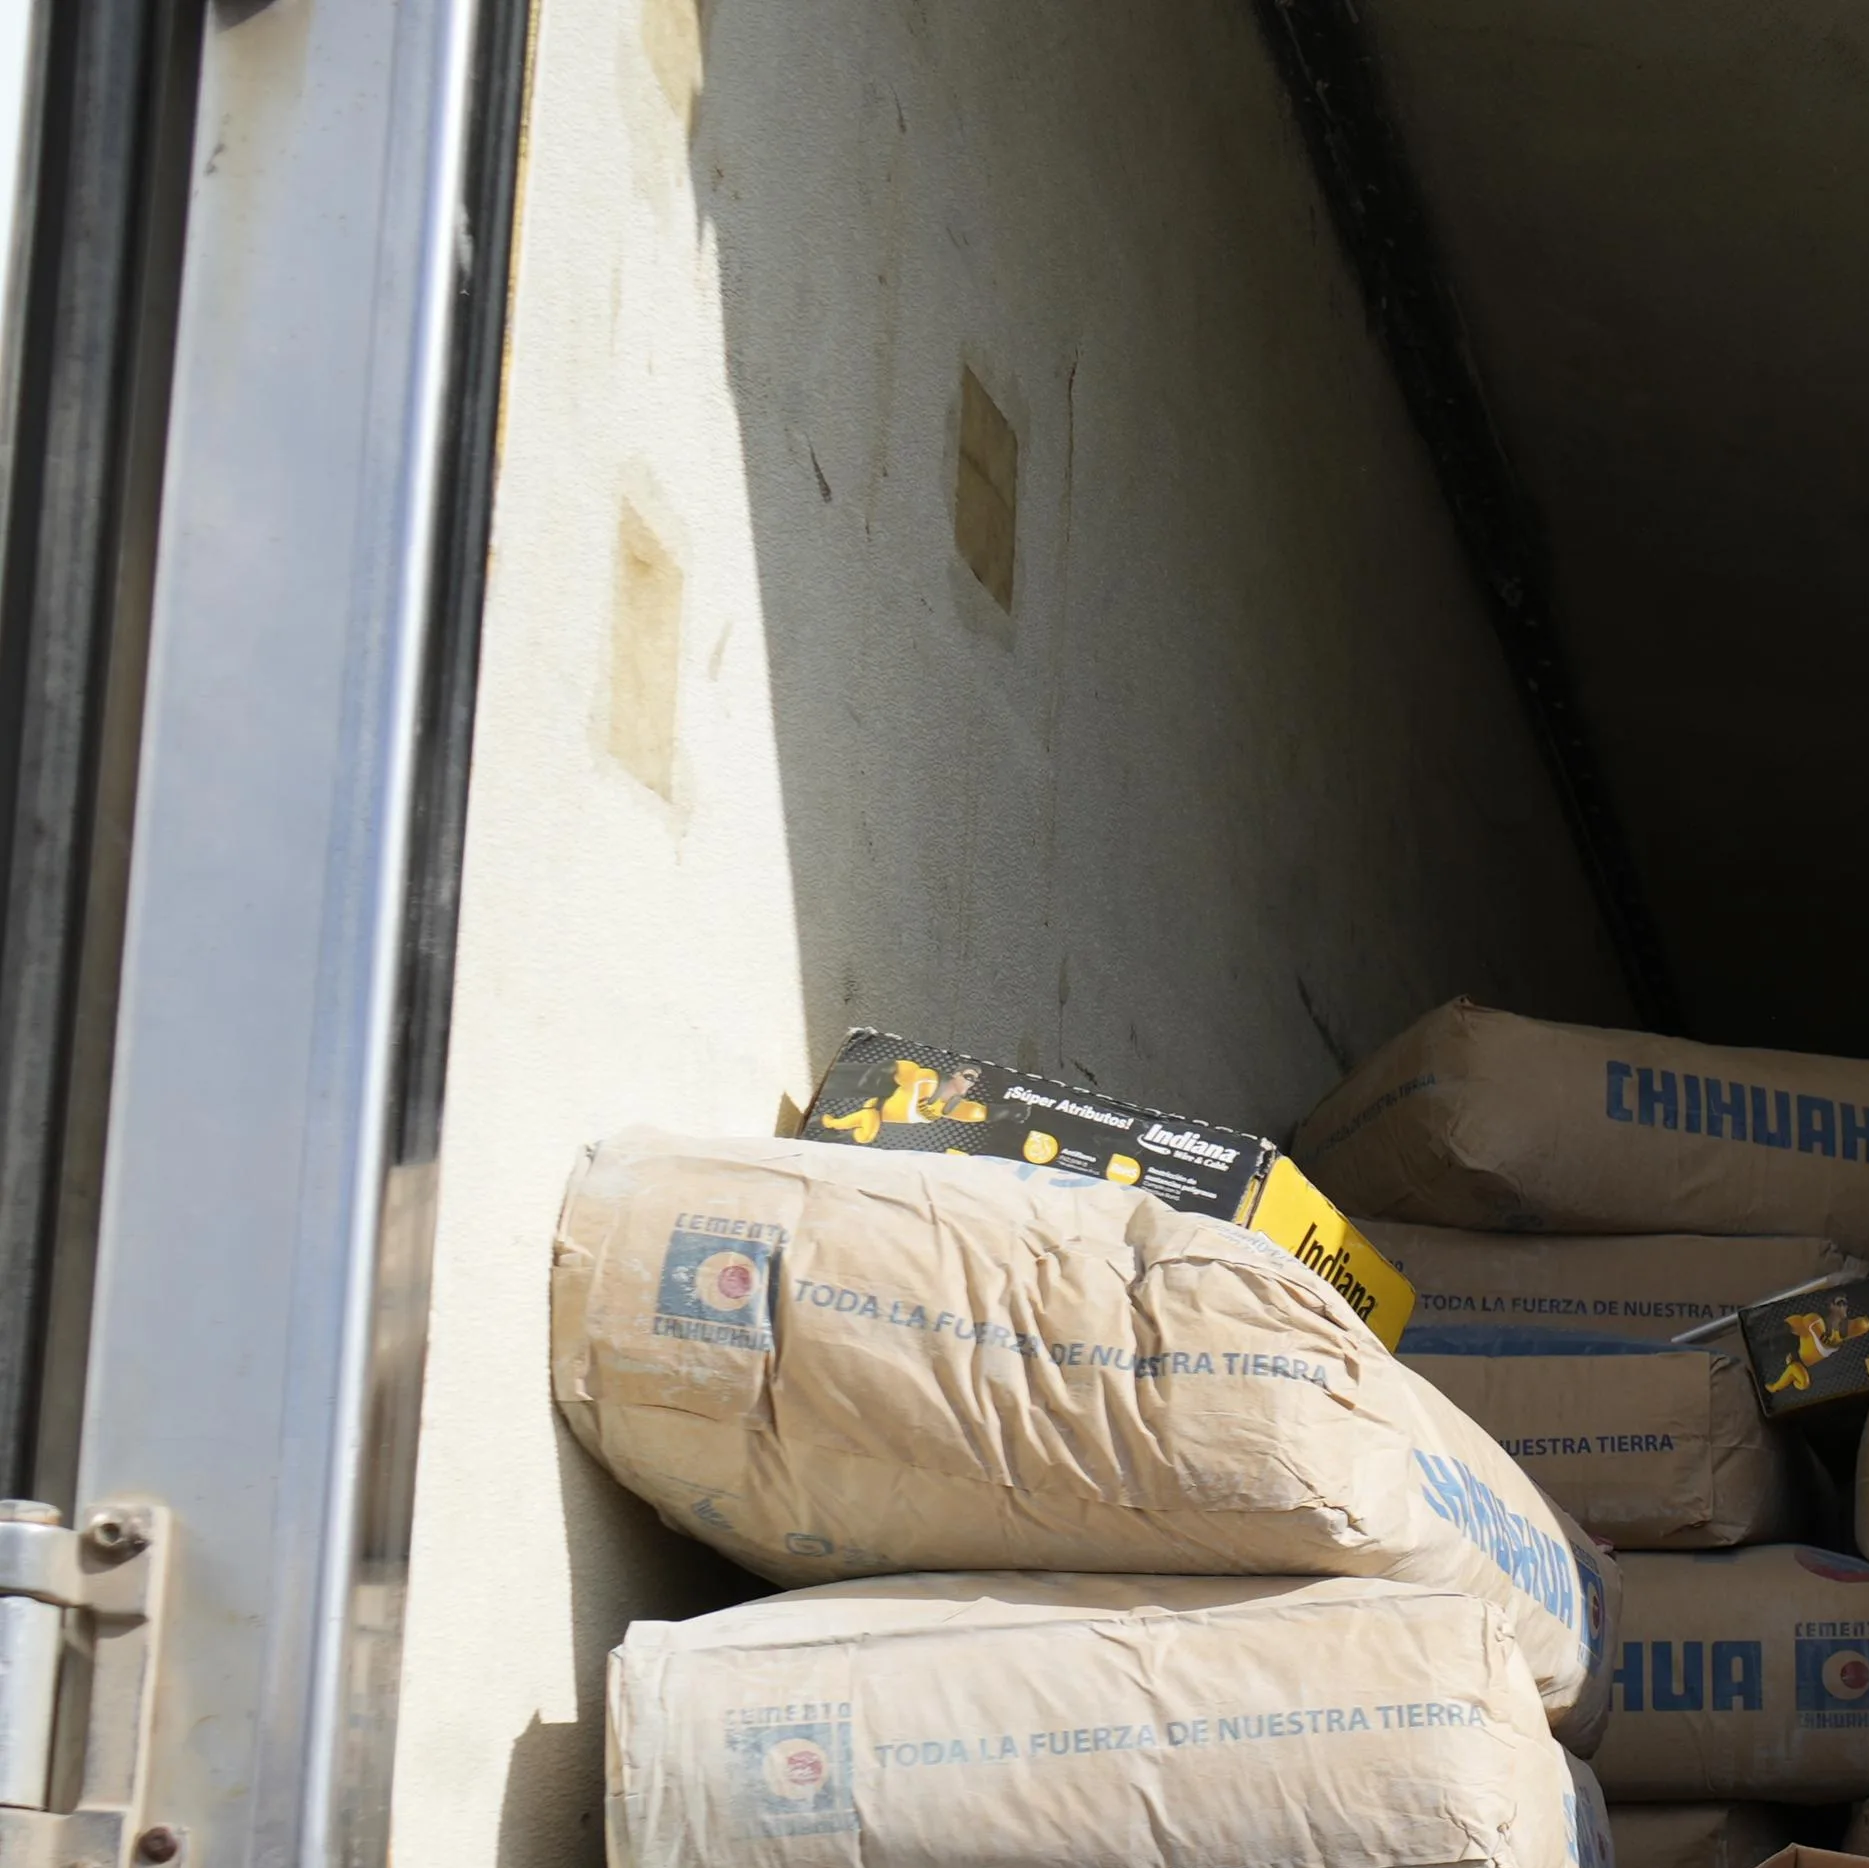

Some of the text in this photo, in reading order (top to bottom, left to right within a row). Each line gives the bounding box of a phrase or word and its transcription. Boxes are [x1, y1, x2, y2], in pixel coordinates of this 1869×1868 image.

[1003, 1086, 1134, 1131] ¡Súper Atributos!
[1144, 1123, 1239, 1165] Indiana
[674, 1211, 789, 1248] CEMENTO
[1420, 1293, 1475, 1312] TODA
[1482, 1295, 1506, 1312] LA
[1512, 1296, 1587, 1315] FUERZA
[1593, 1299, 1619, 1316] DE
[1624, 1300, 1714, 1319] NUESTRA
[794, 1278, 1328, 1384] TODA LA FUERZA DE NUESTRA TIERRA
[1596, 1433, 1674, 1455] TIERRA
[874, 1701, 1487, 1769] TODA LA FUERZA DE NUESTRA TIERRA
